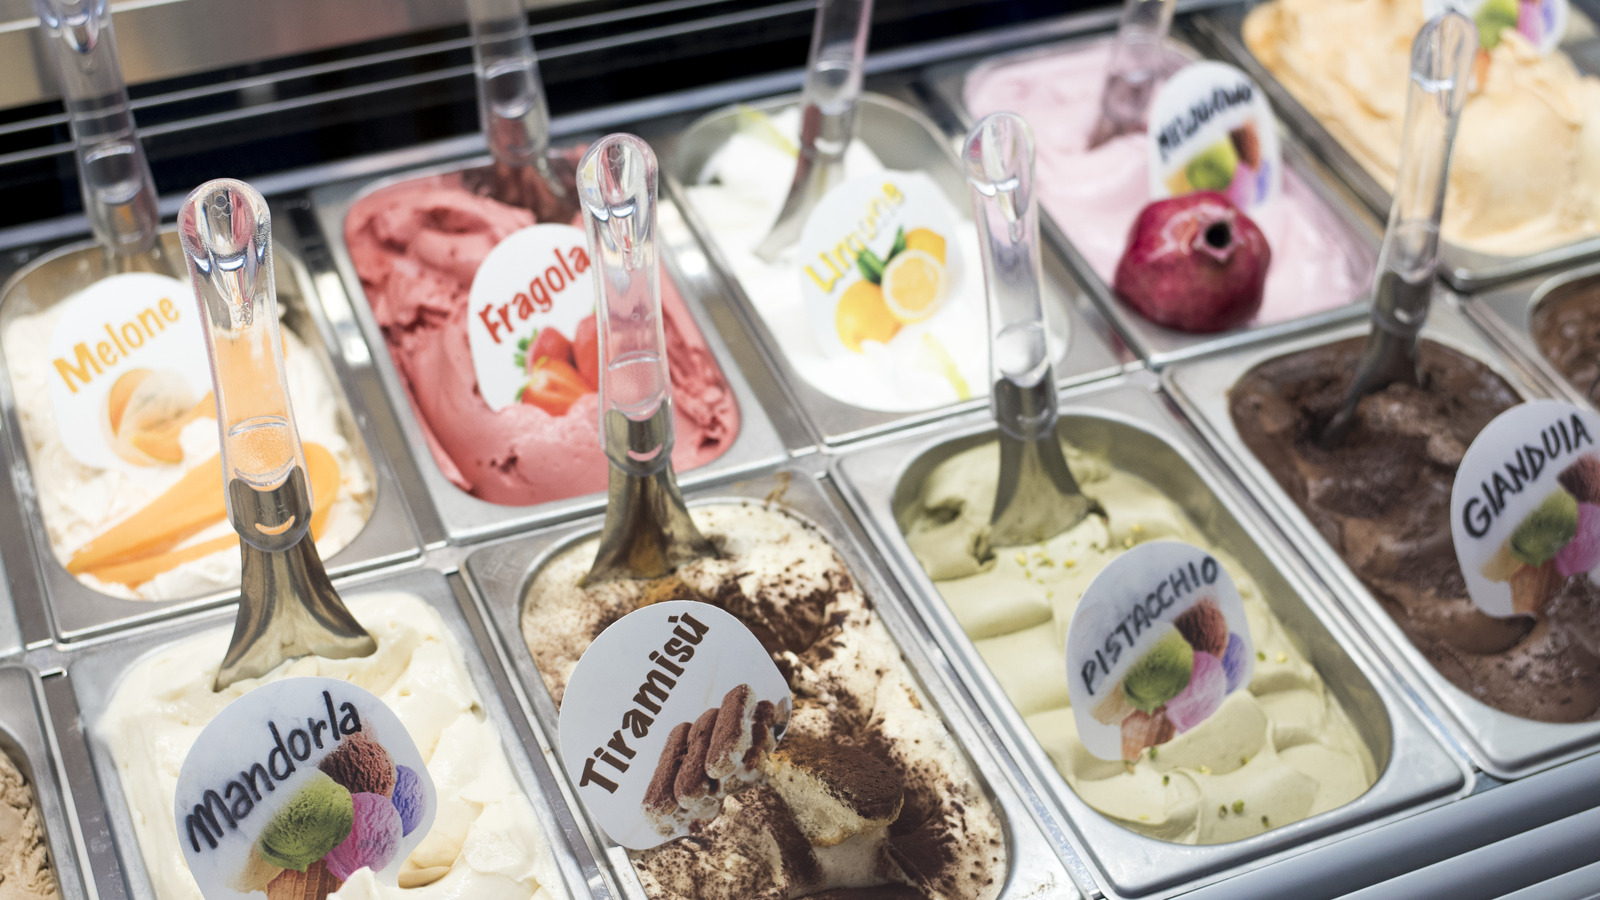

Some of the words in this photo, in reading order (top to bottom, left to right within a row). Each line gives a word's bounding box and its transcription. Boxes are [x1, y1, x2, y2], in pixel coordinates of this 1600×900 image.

[52, 297, 180, 395] Melone
[478, 246, 592, 345] Fragola
[1462, 412, 1594, 539] GIANDUIA
[1080, 555, 1219, 696] PISTACCHIO
[579, 602, 710, 794] Tiramisù
[185, 690, 362, 853] Mandorla
